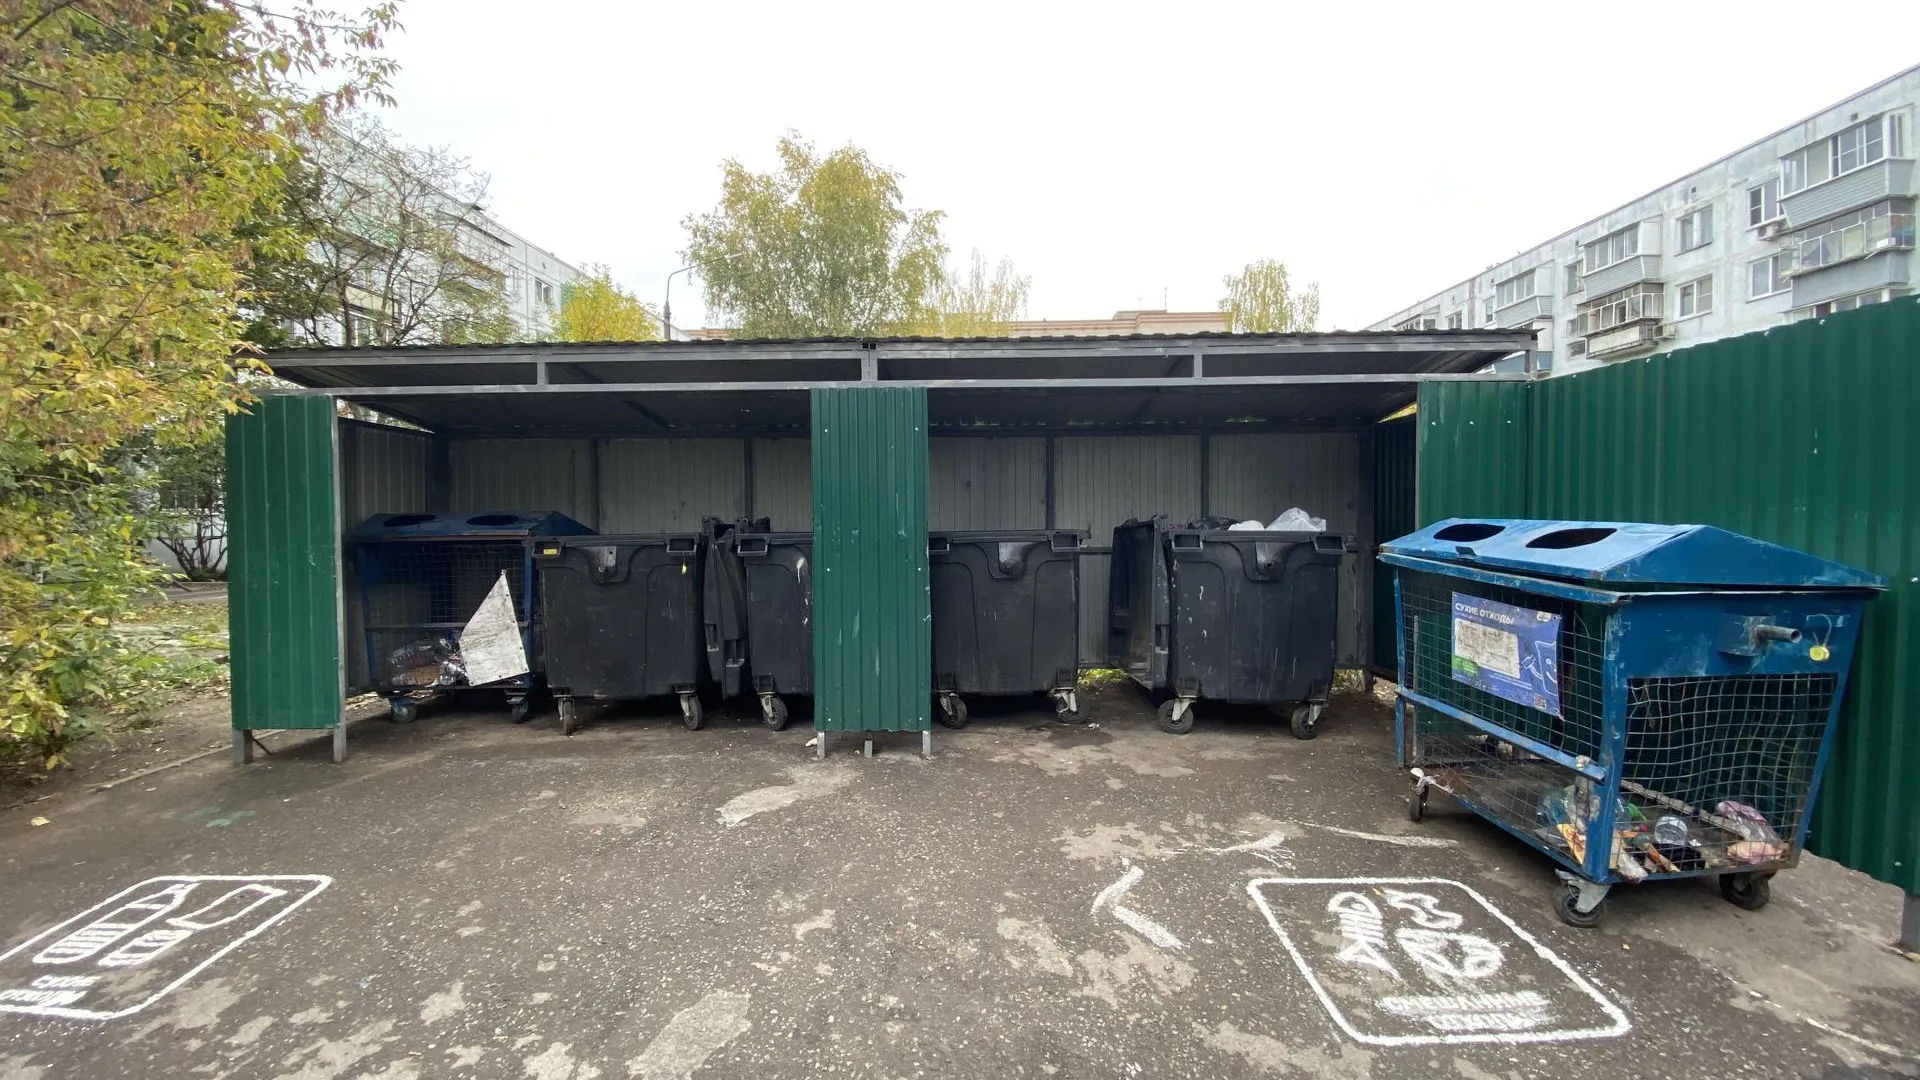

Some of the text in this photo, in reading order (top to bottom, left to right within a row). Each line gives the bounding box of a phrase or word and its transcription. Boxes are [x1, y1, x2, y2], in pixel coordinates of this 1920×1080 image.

[1455, 602, 1478, 614] СУХИЕ
[1479, 609, 1514, 624] ОТХОДЫ
[1381, 990, 1551, 1011] СМЕШАННЫЕ
